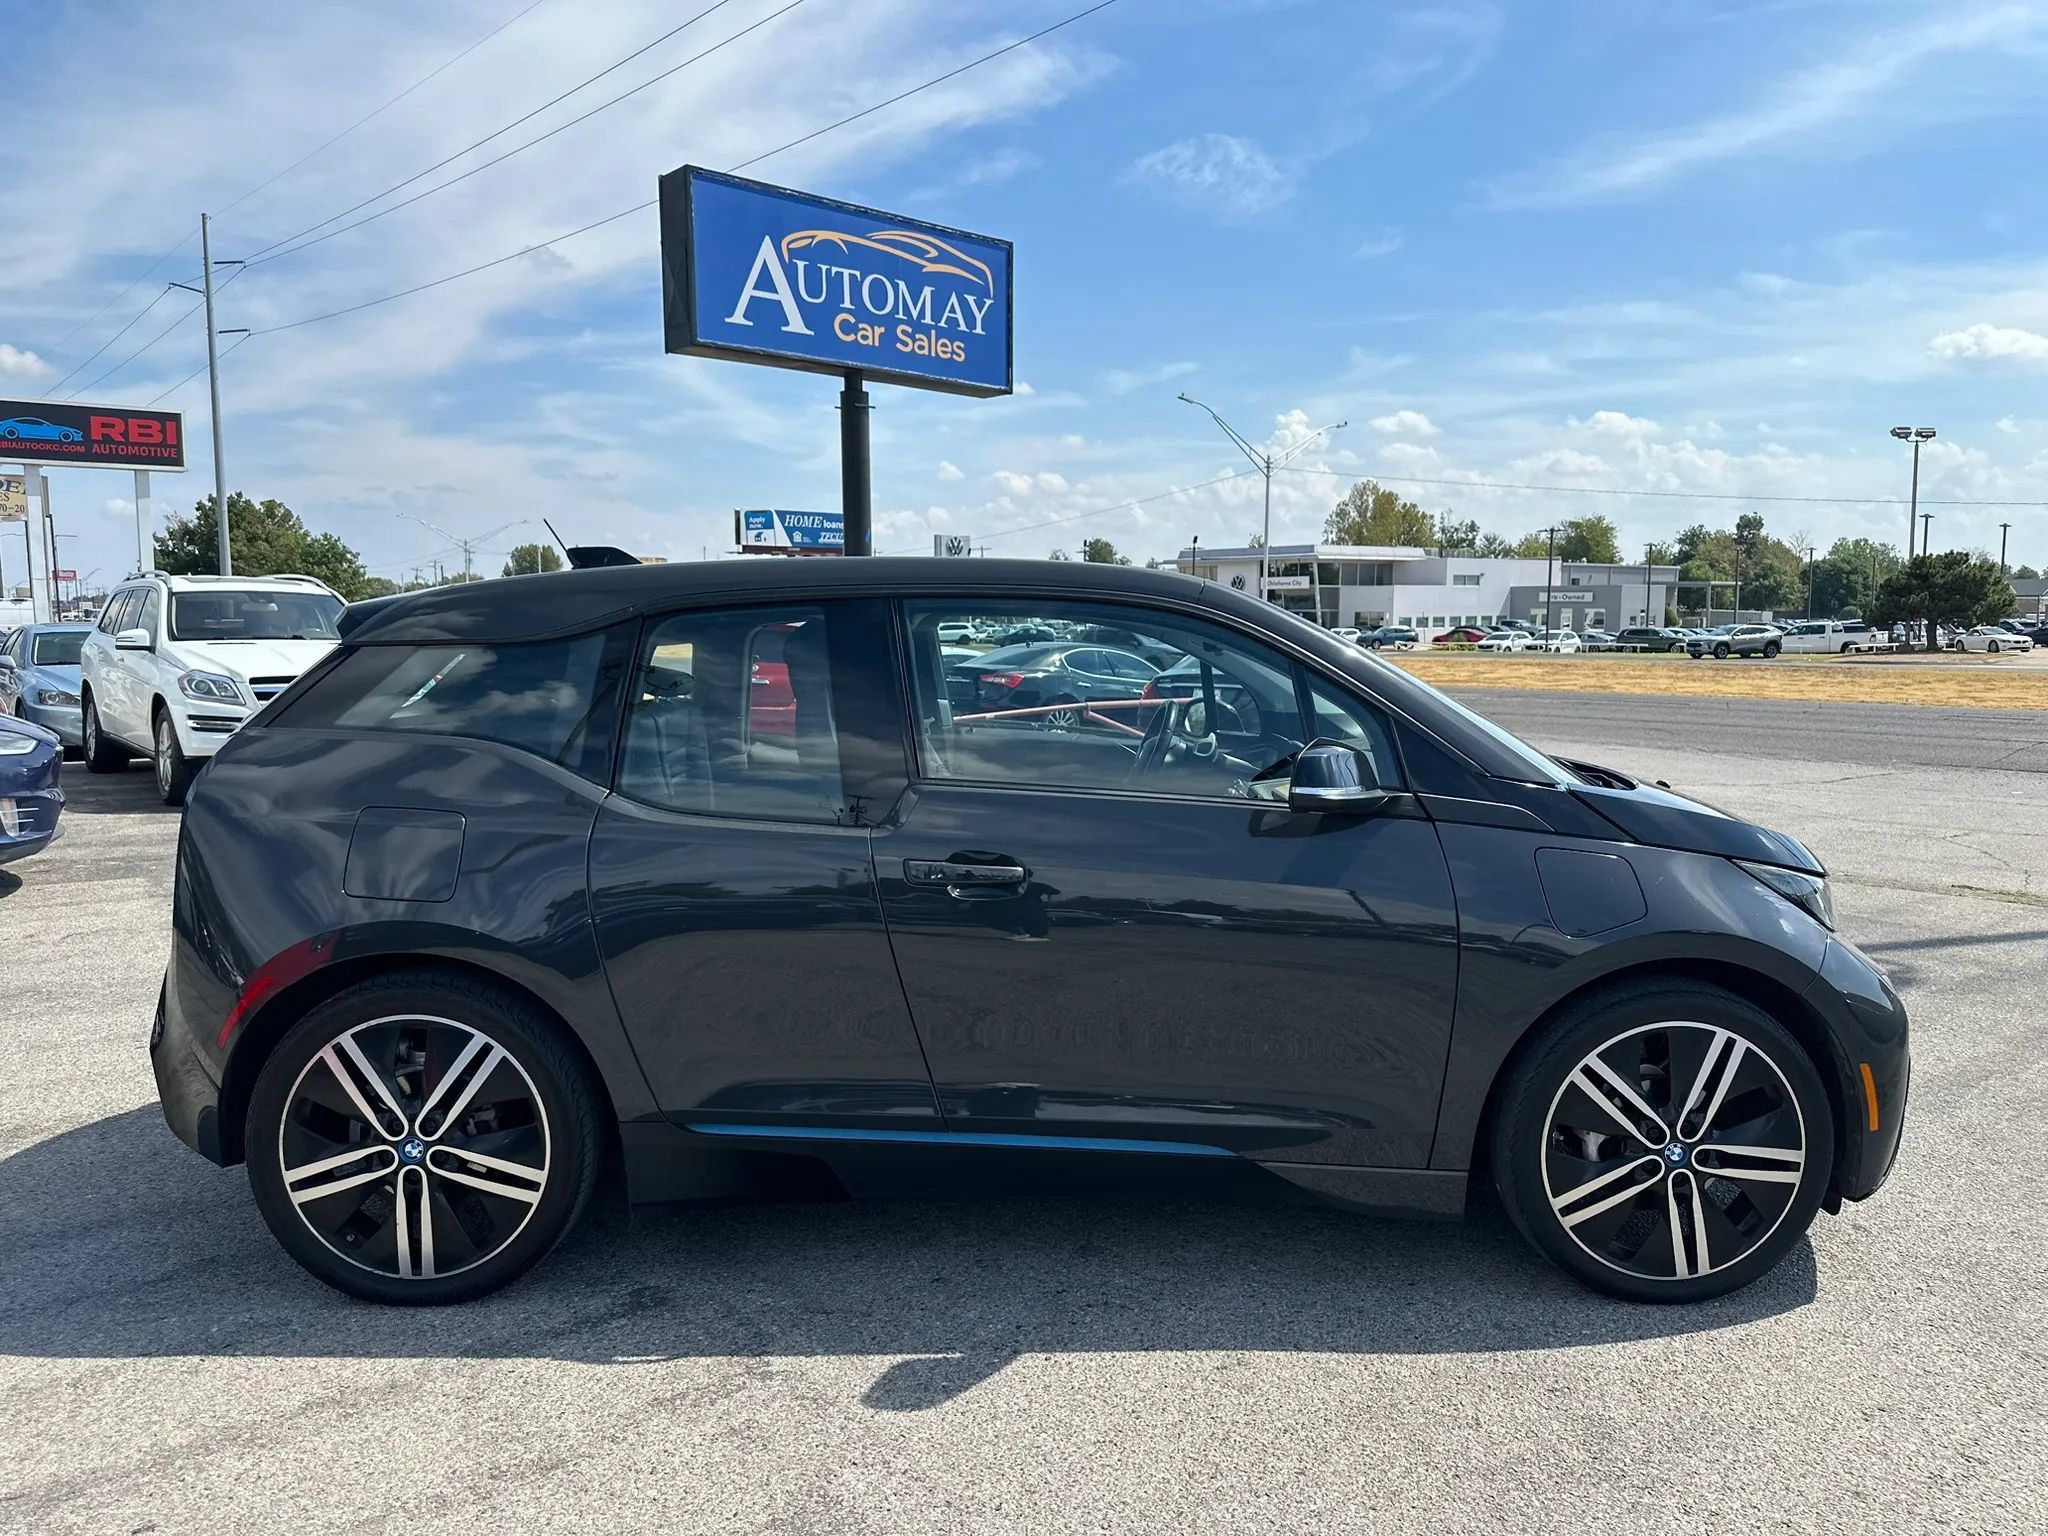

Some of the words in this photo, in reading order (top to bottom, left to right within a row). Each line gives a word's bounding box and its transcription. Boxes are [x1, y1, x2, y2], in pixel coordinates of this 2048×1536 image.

[833, 313, 886, 347] Car
[895, 324, 966, 363] Sales
[90, 416, 178, 445] RBI
[92, 443, 178, 458] AUTOMOTIVE
[784, 514, 823, 528] HOME
